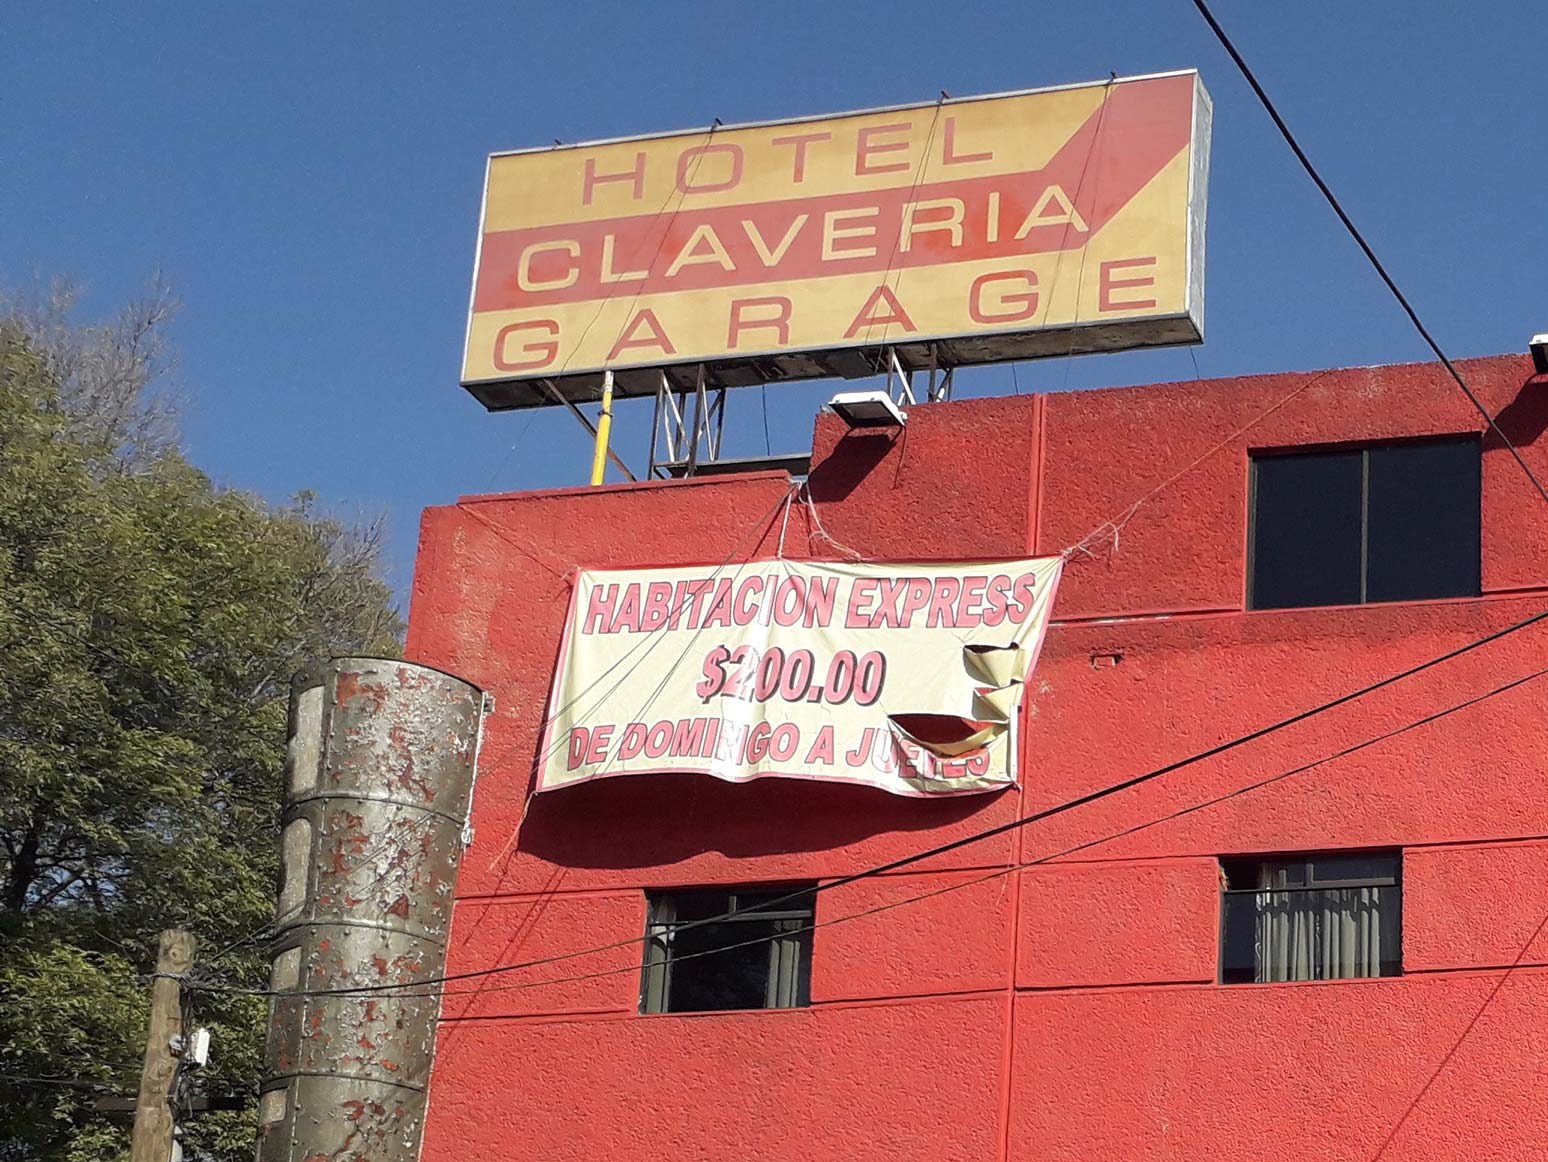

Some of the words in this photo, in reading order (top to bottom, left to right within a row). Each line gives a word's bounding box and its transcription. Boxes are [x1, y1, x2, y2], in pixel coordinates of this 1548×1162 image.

[582, 116, 994, 206] HOTEL
[516, 183, 1091, 294] CLAVERIA
[492, 256, 1157, 372] GARAGE
[582, 573, 840, 635] HABITACION
[844, 571, 1037, 630] EXPRESS
[695, 644, 887, 708] $200.00
[567, 724, 616, 771] DE
[617, 717, 801, 766] DOMINGO
[804, 725, 836, 766] A
